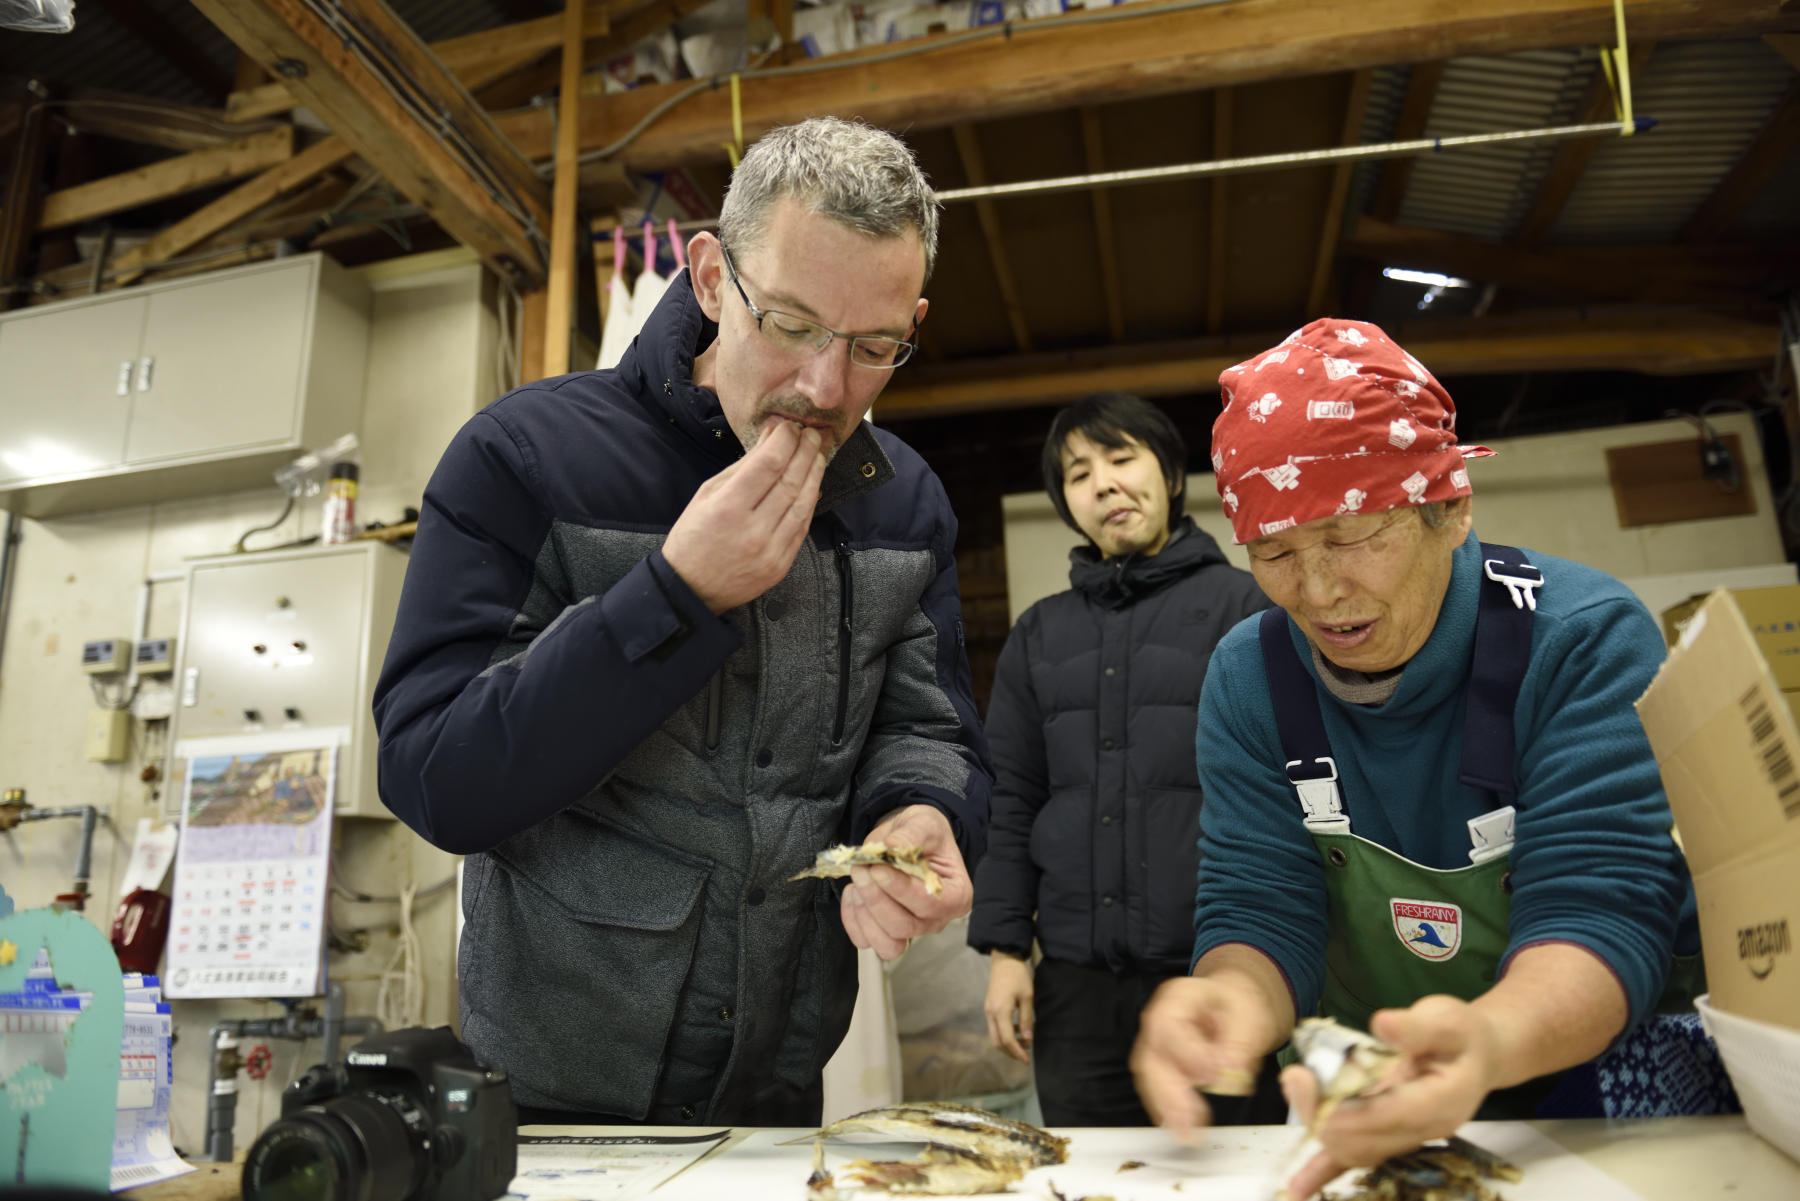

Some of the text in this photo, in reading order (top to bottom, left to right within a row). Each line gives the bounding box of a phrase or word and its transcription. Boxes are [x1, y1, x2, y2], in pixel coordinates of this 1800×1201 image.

[1394, 904, 1455, 921] FRESHRAINY
[1737, 918, 1791, 960] amazon
[348, 1052, 388, 1066] Canon
